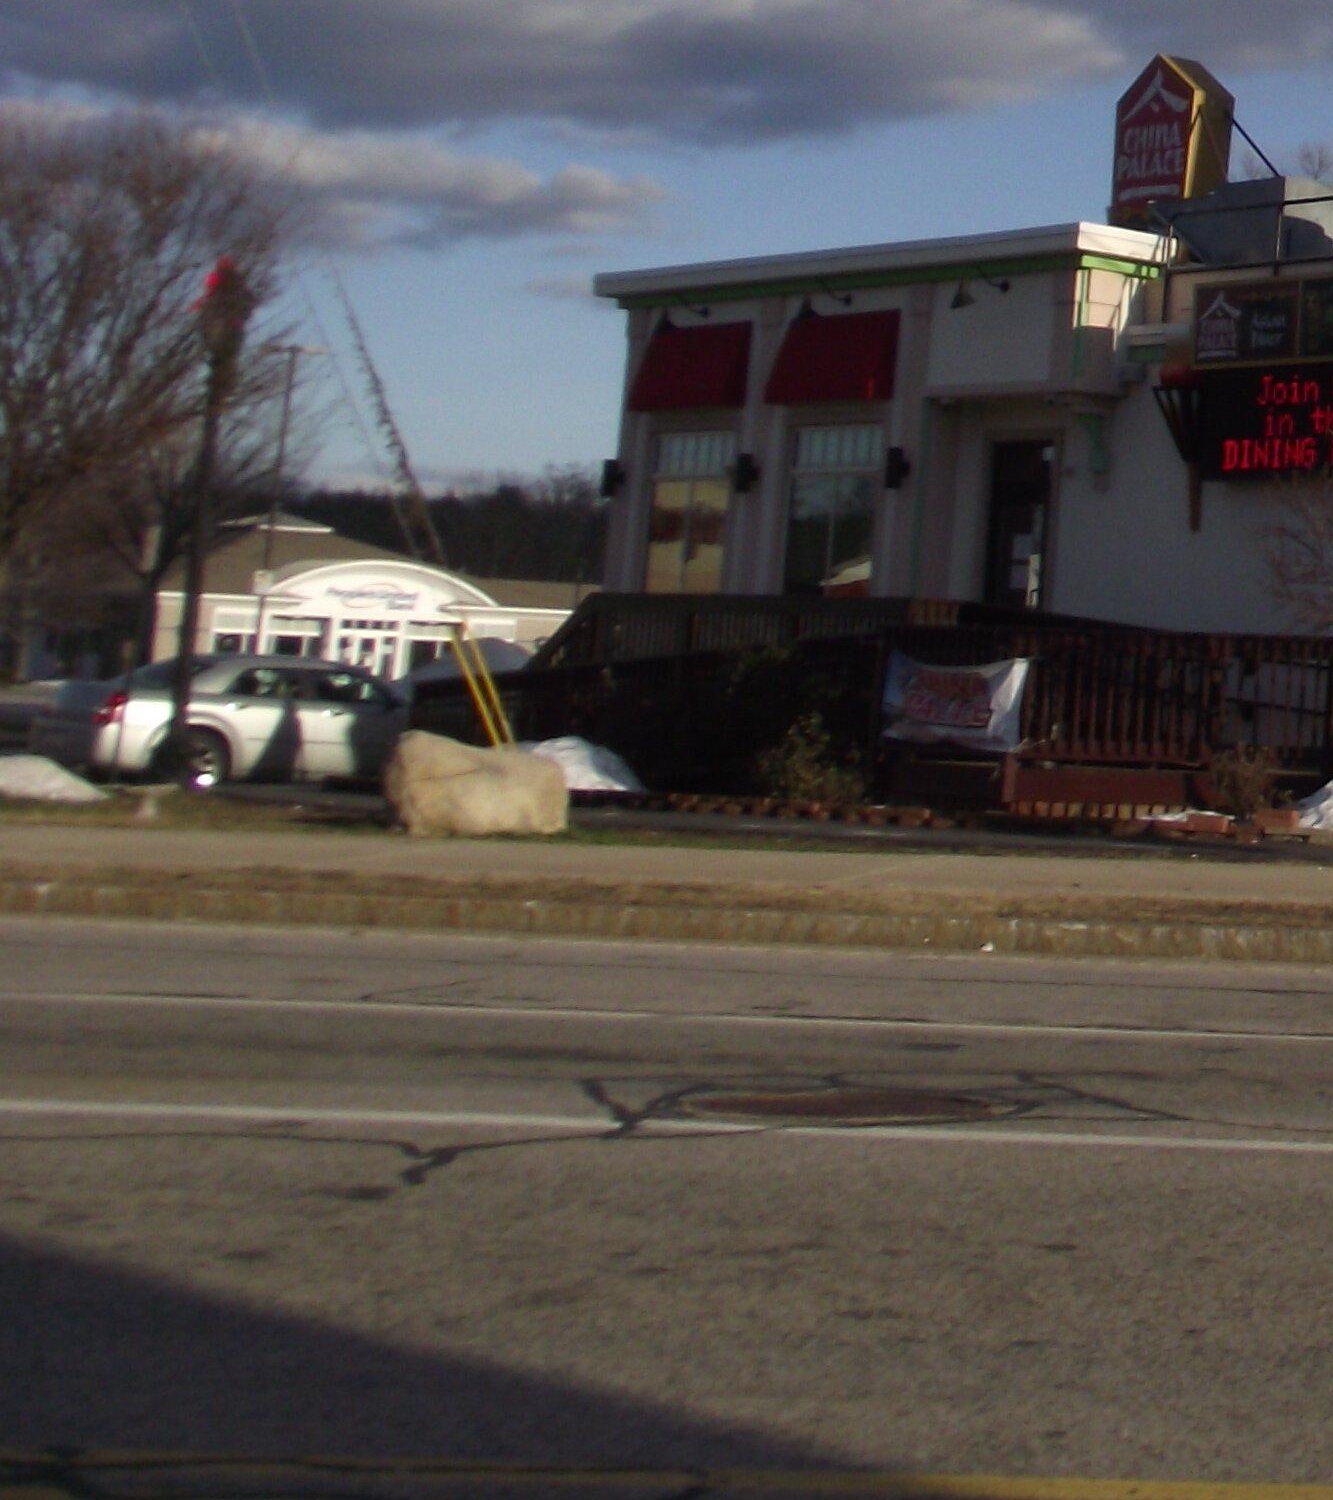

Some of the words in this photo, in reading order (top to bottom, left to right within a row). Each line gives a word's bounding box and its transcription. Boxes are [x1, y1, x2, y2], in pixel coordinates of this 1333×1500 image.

[1124, 121, 1181, 152] CHINA
[1118, 148, 1184, 179] PALACE
[1258, 374, 1320, 405] Join
[1265, 409, 1294, 435] in
[1222, 439, 1317, 470] DINING
